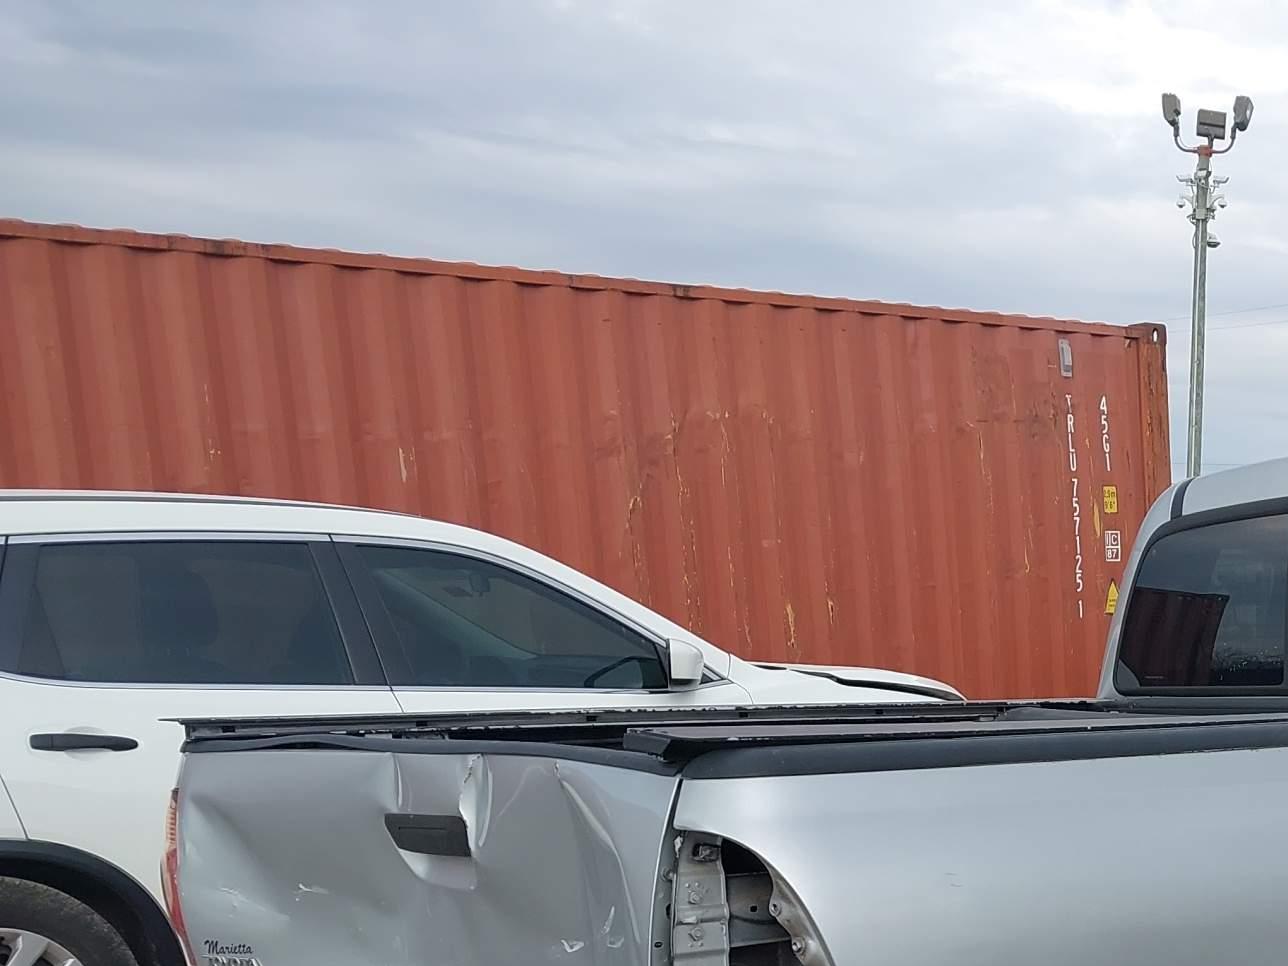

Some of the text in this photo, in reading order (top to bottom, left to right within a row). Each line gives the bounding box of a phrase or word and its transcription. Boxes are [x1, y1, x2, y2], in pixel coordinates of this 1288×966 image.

[1100, 396, 1111, 471] 45G1
[1065, 394, 1076, 471] TRLU
[1072, 478, 1083, 592] 757125
[204, 940, 253, 955] Marietta
